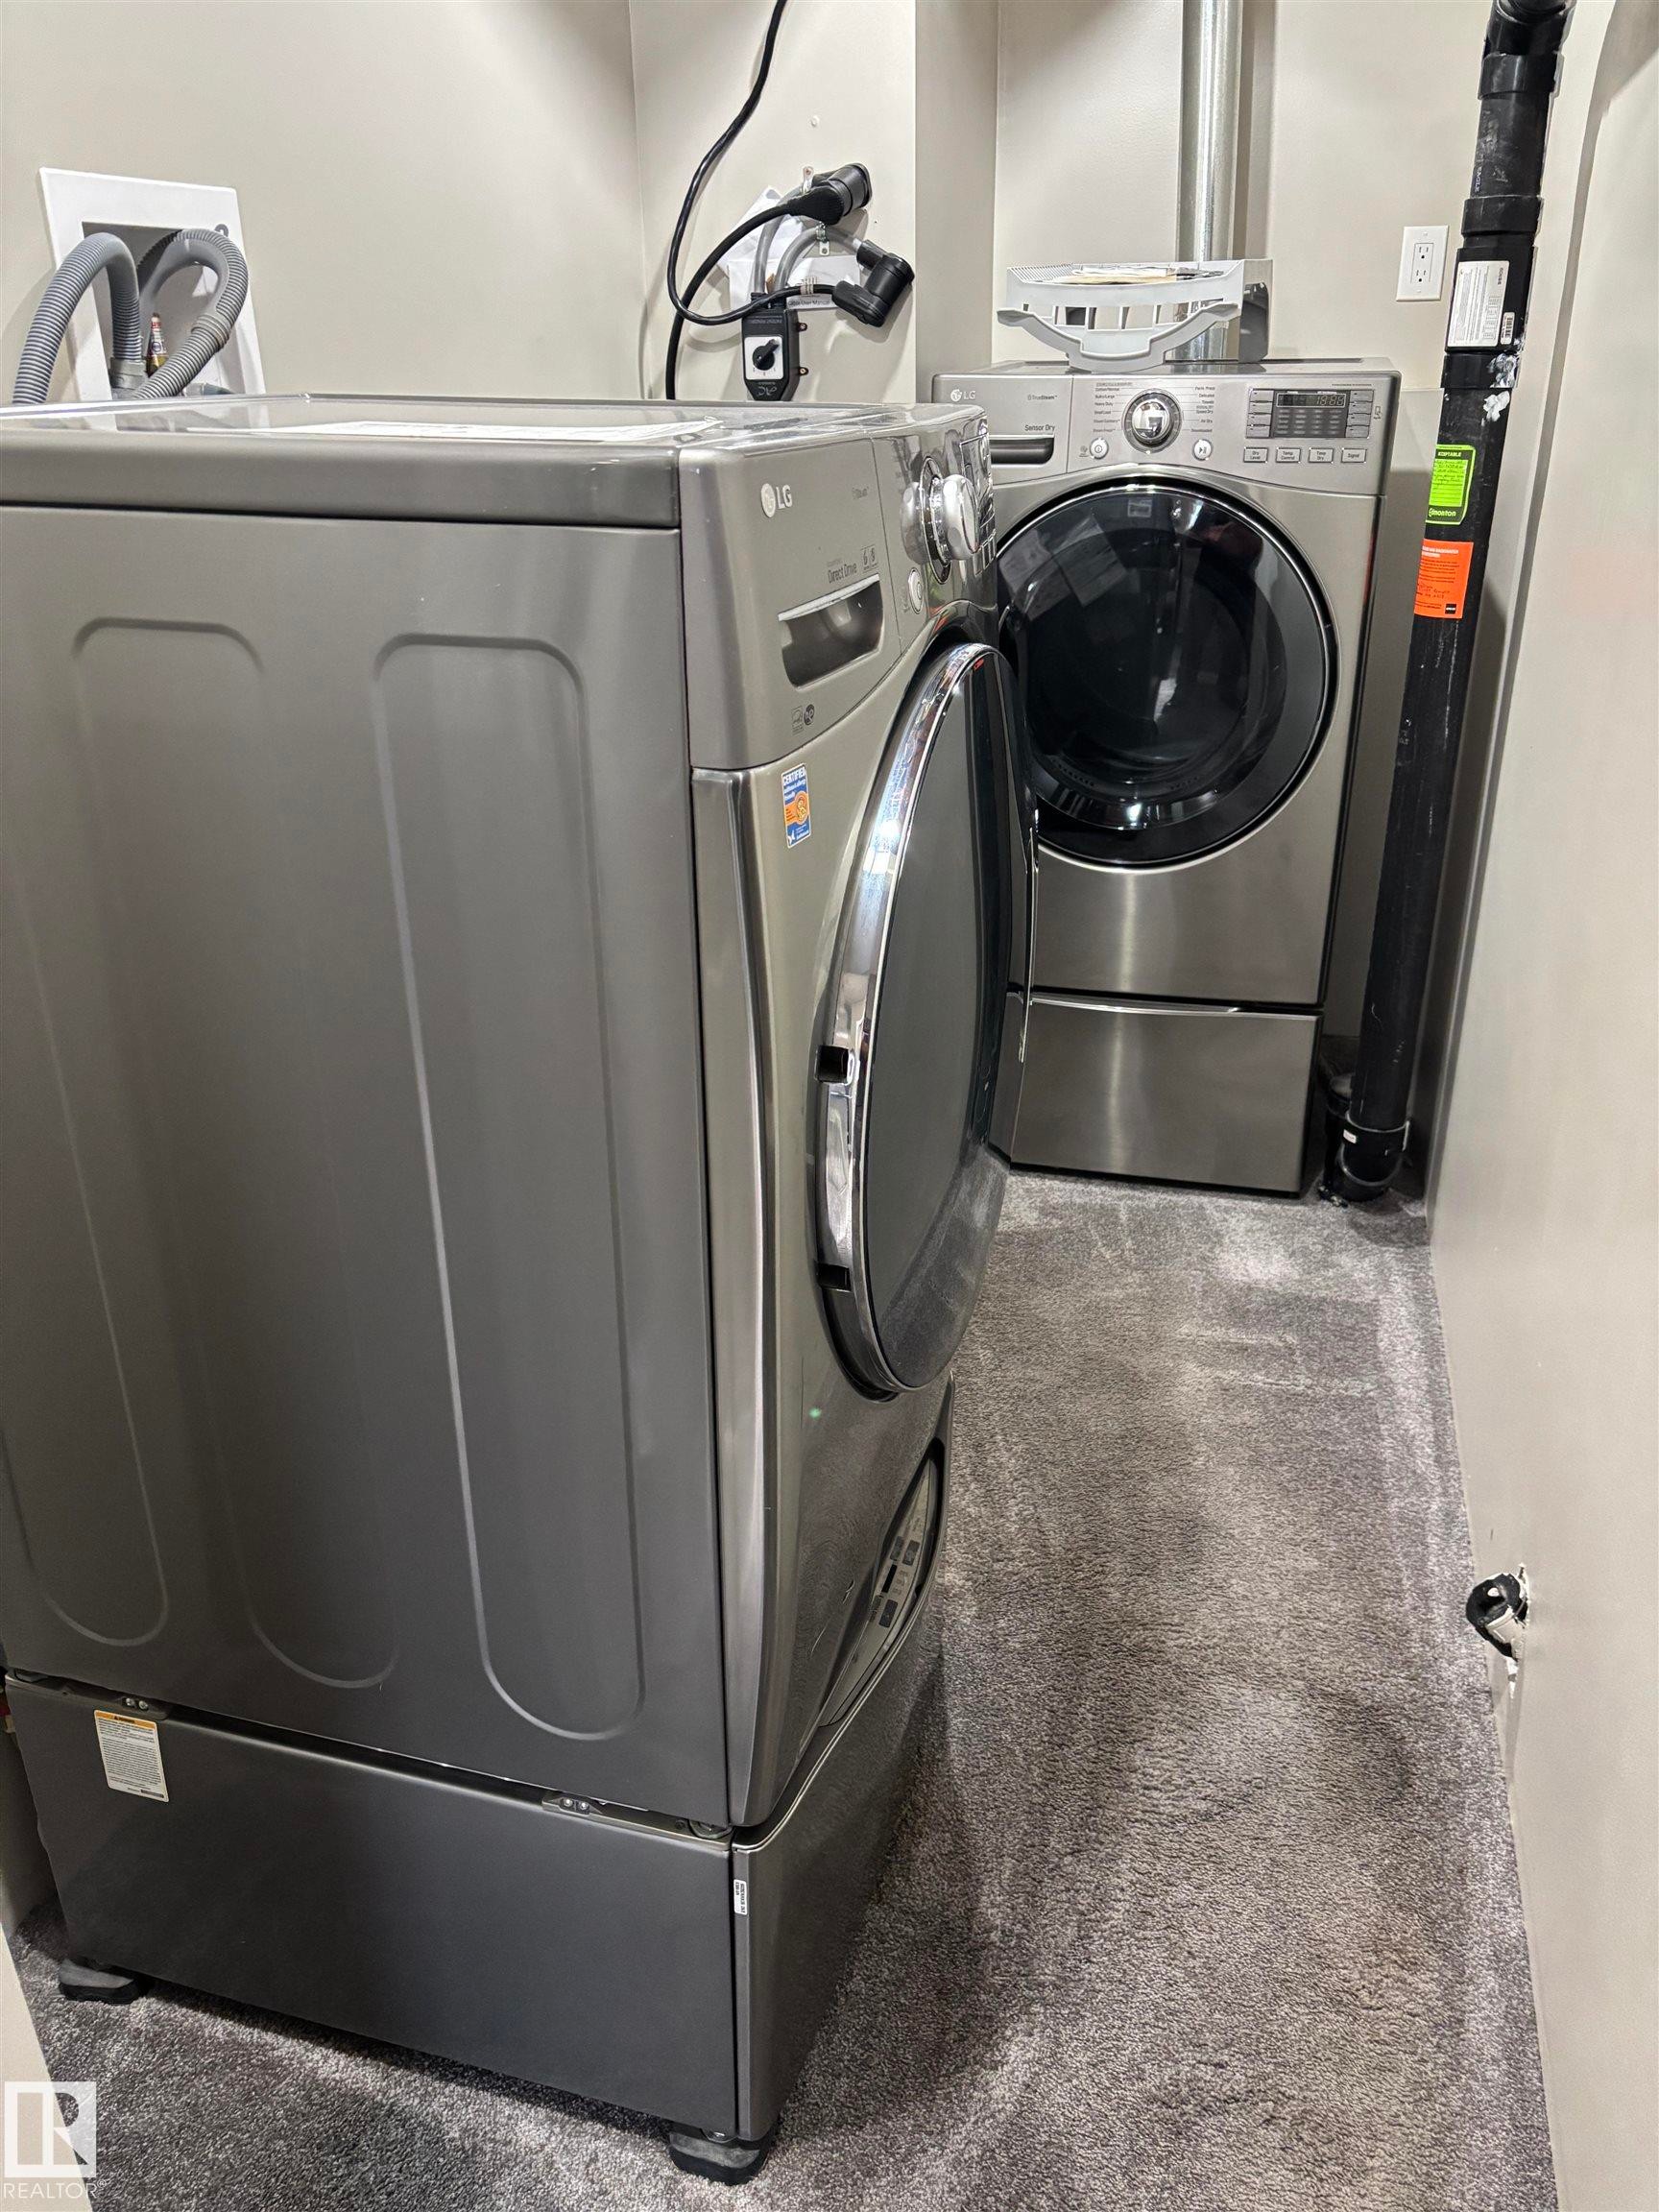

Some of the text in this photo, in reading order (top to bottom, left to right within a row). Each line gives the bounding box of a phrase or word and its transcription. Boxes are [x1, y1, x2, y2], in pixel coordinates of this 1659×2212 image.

[963, 390, 976, 399] LG
[776, 484, 793, 510] LG
[828, 565, 845, 583] Direct
[844, 563, 857, 577] Drive
